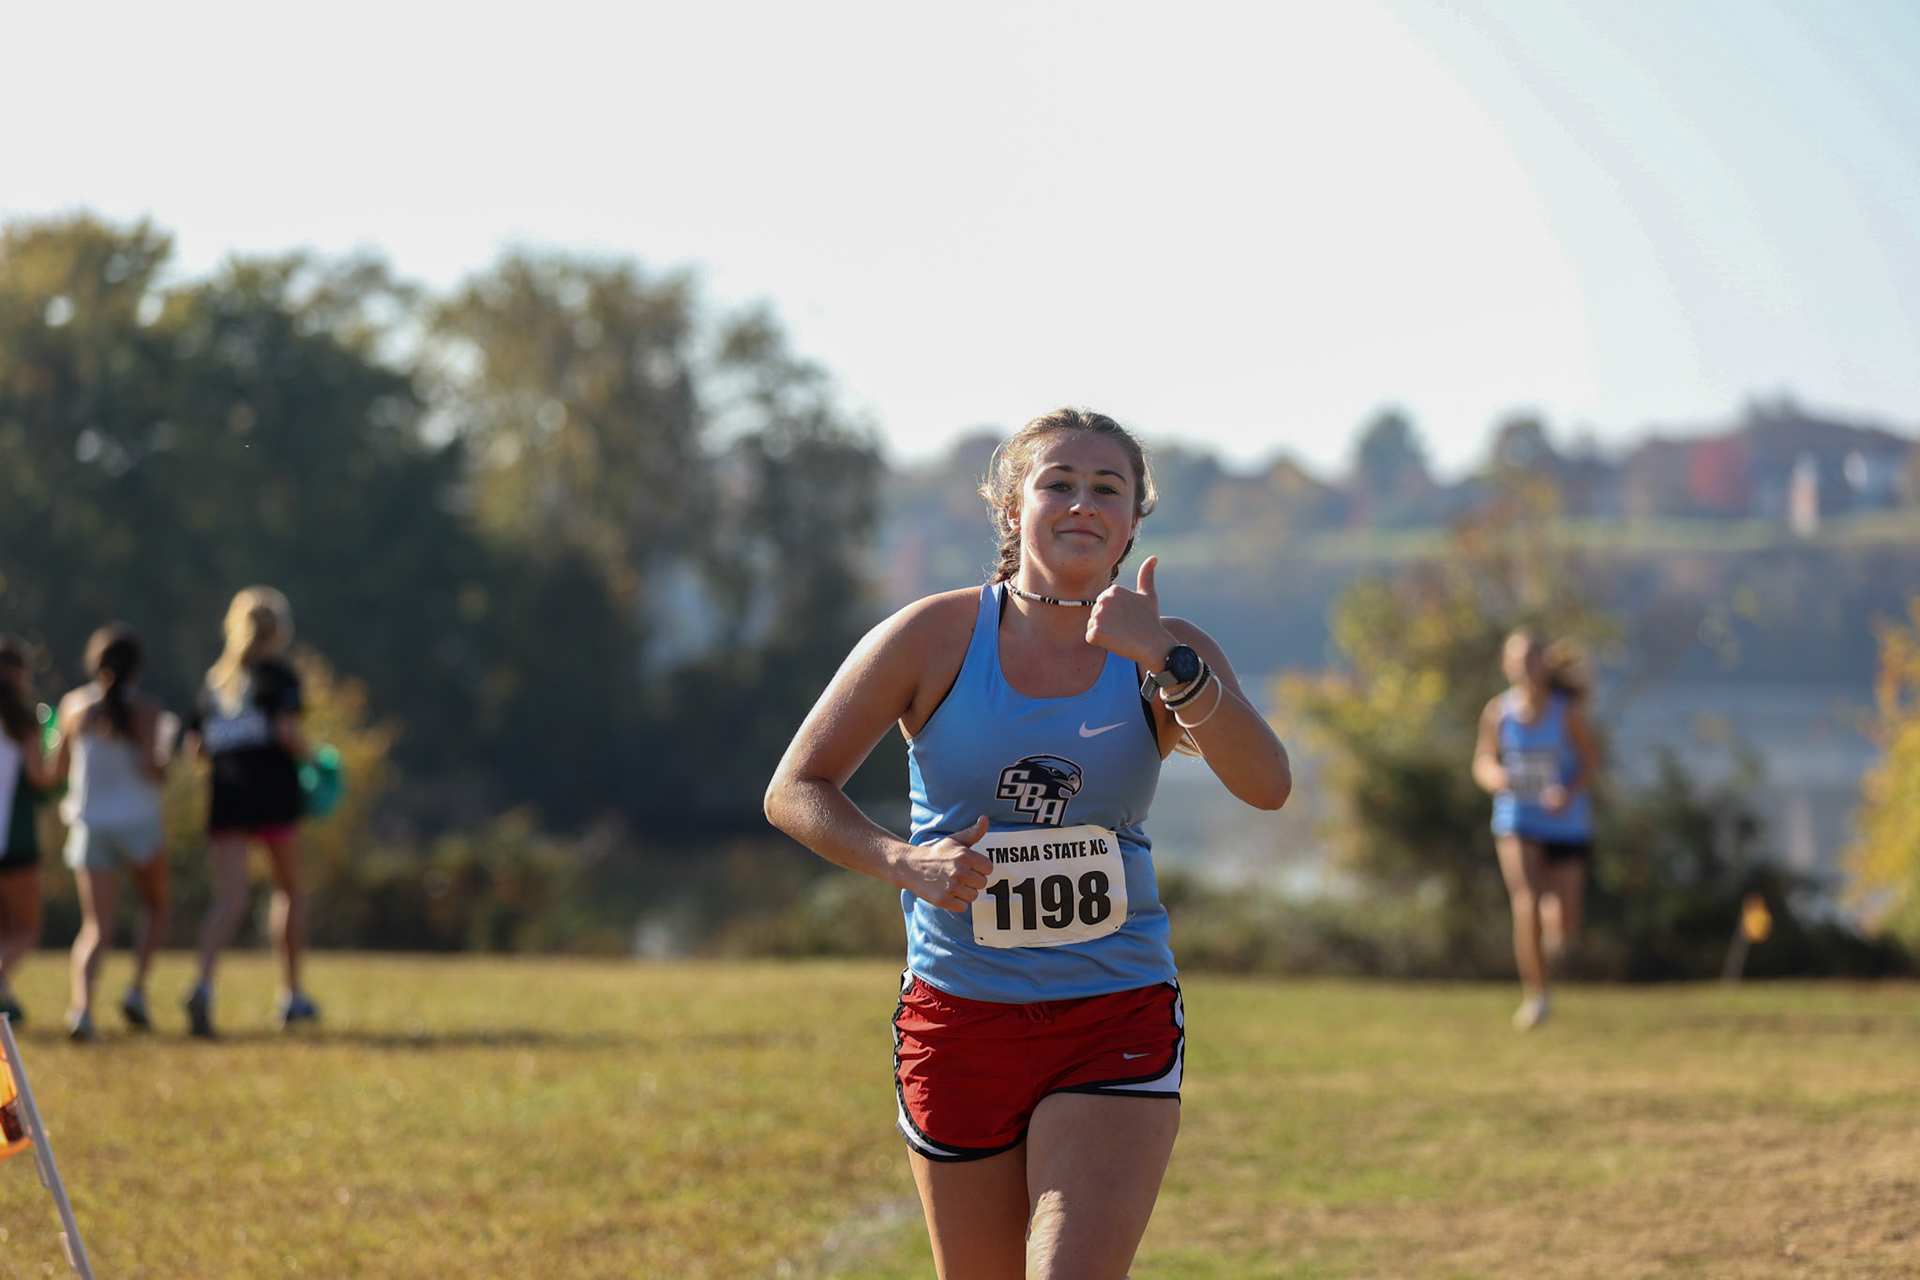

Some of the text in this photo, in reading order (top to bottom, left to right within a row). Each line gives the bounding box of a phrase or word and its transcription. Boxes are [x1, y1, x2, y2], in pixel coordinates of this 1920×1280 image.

[1000, 769, 1066, 825] SBA
[986, 838, 1108, 864] TMSAA STATE XC
[986, 870, 1111, 930] 1198
